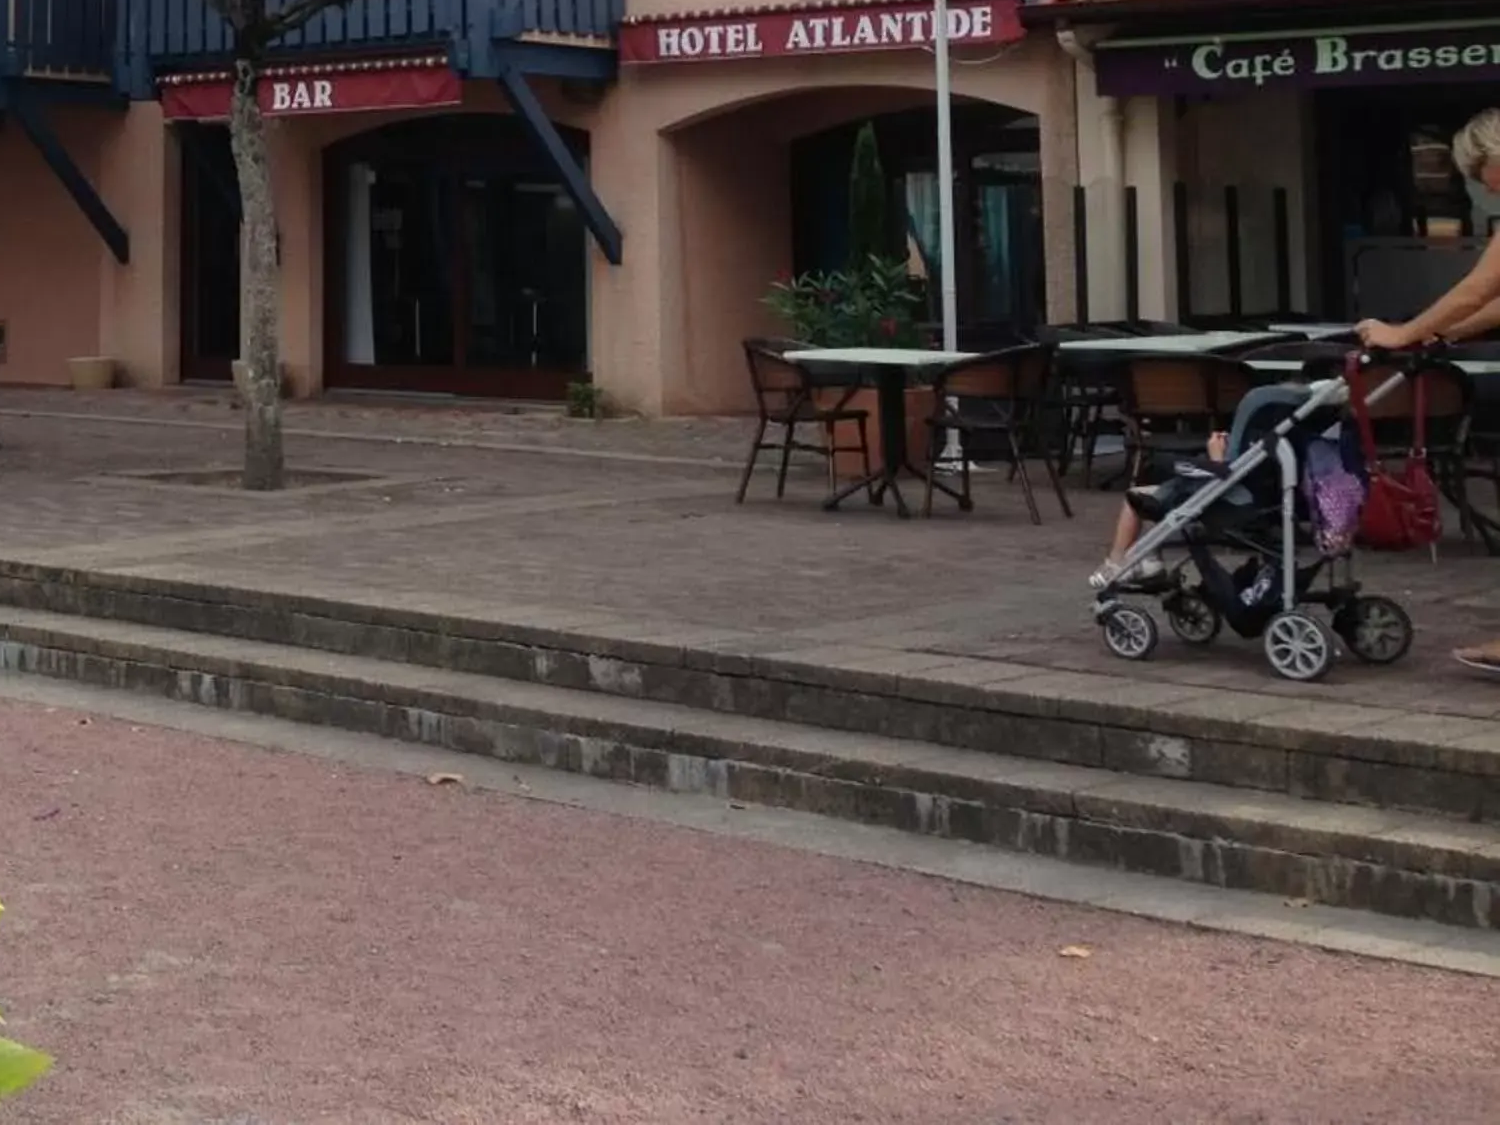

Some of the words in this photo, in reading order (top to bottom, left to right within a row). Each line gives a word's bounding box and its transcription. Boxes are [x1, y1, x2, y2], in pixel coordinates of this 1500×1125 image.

[657, 22, 763, 57] HOTEL
[1191, 34, 1296, 86] Café
[273, 79, 333, 110] BAR
